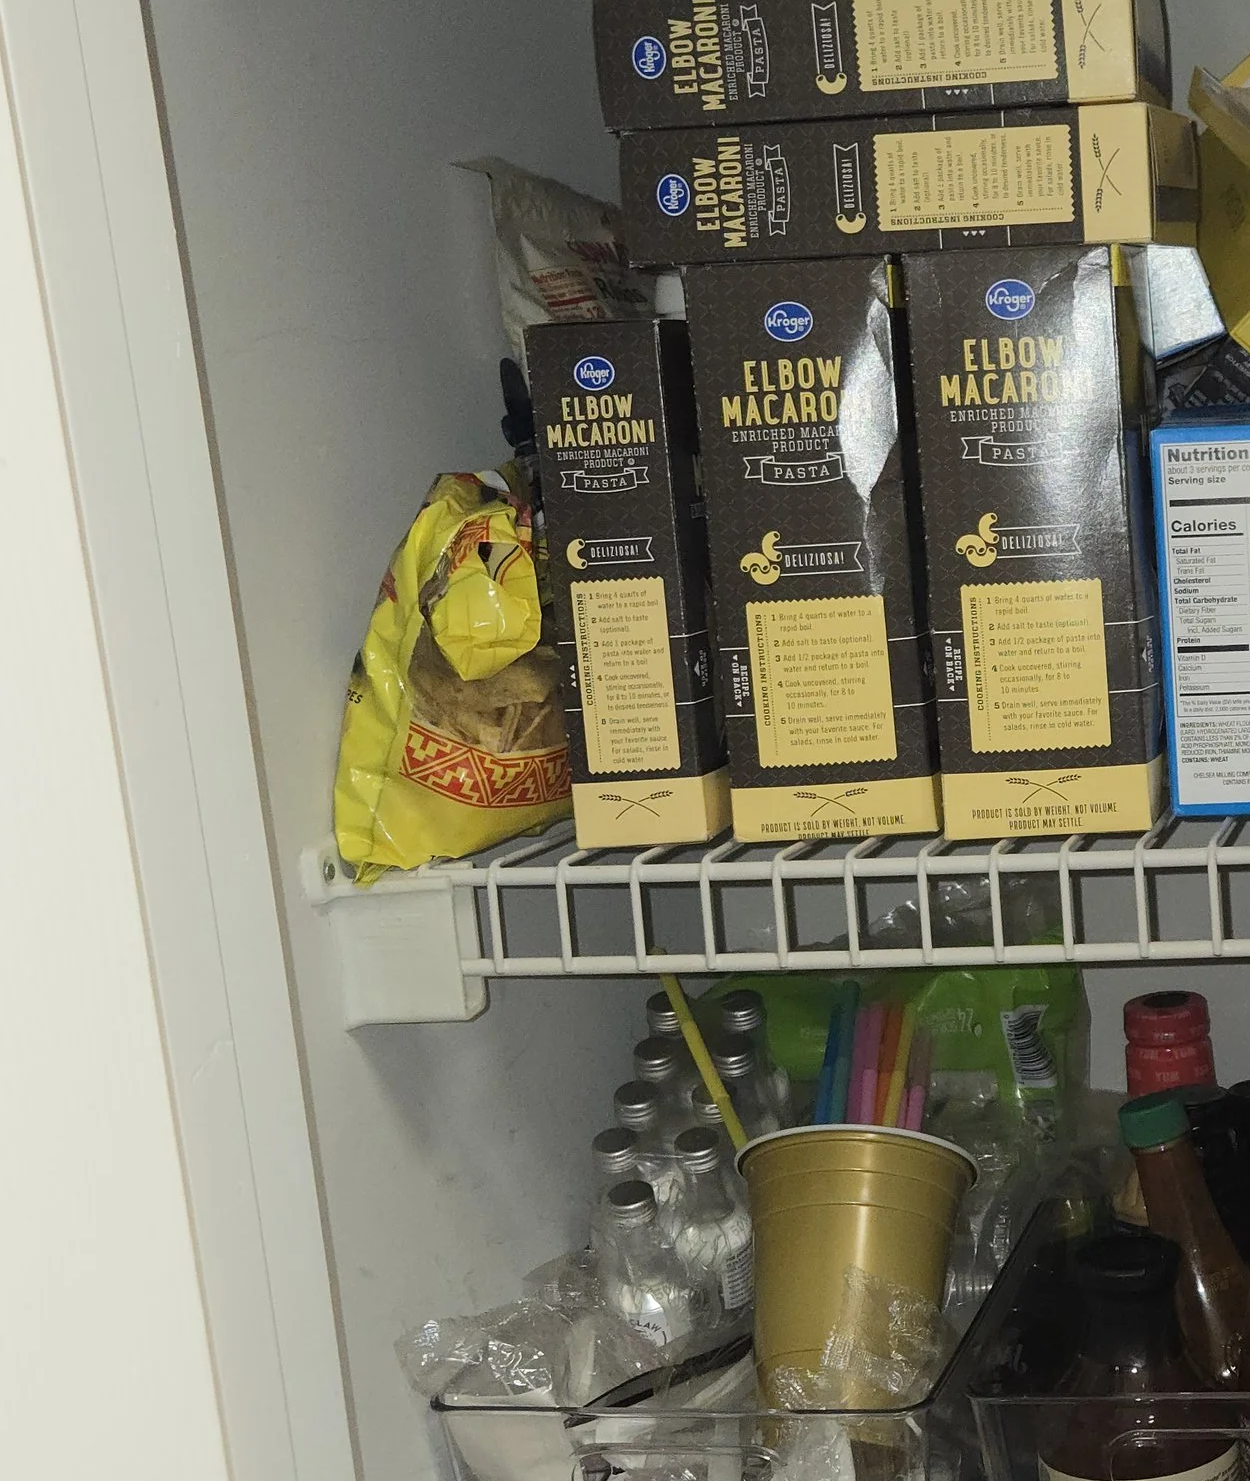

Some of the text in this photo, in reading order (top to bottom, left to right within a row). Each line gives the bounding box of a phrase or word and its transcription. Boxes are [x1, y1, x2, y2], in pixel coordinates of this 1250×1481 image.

[668, 19, 698, 94] ELBOW
[752, 27, 764, 73] PASTA
[819, 18, 835, 70] DELIZIOSA!
[692, 158, 720, 231] ELBOW
[717, 137, 747, 248] MACARONI
[775, 167, 786, 212] PASTA
[988, 287, 1032, 312] Kroger
[768, 309, 810, 334] Kroger
[963, 336, 1064, 371] ELBOW
[580, 362, 610, 385] Kroger
[744, 356, 842, 393] ELBOW
[561, 393, 633, 421] ELBOW
[547, 420, 655, 448] MACARONI
[732, 429, 795, 443] ENRICHED
[557, 447, 649, 461] ENRICHED MACARONI
[584, 458, 623, 468] PRODUCT
[1168, 447, 1249, 462] Nutrition
[584, 477, 627, 488] PASTA
[774, 465, 830, 479] PASTA
[1168, 475, 1226, 485] Serving size
[1171, 519, 1237, 533] Calories
[590, 545, 639, 558] DELIZIOSA!
[785, 551, 845, 567] DELIZIOSA!
